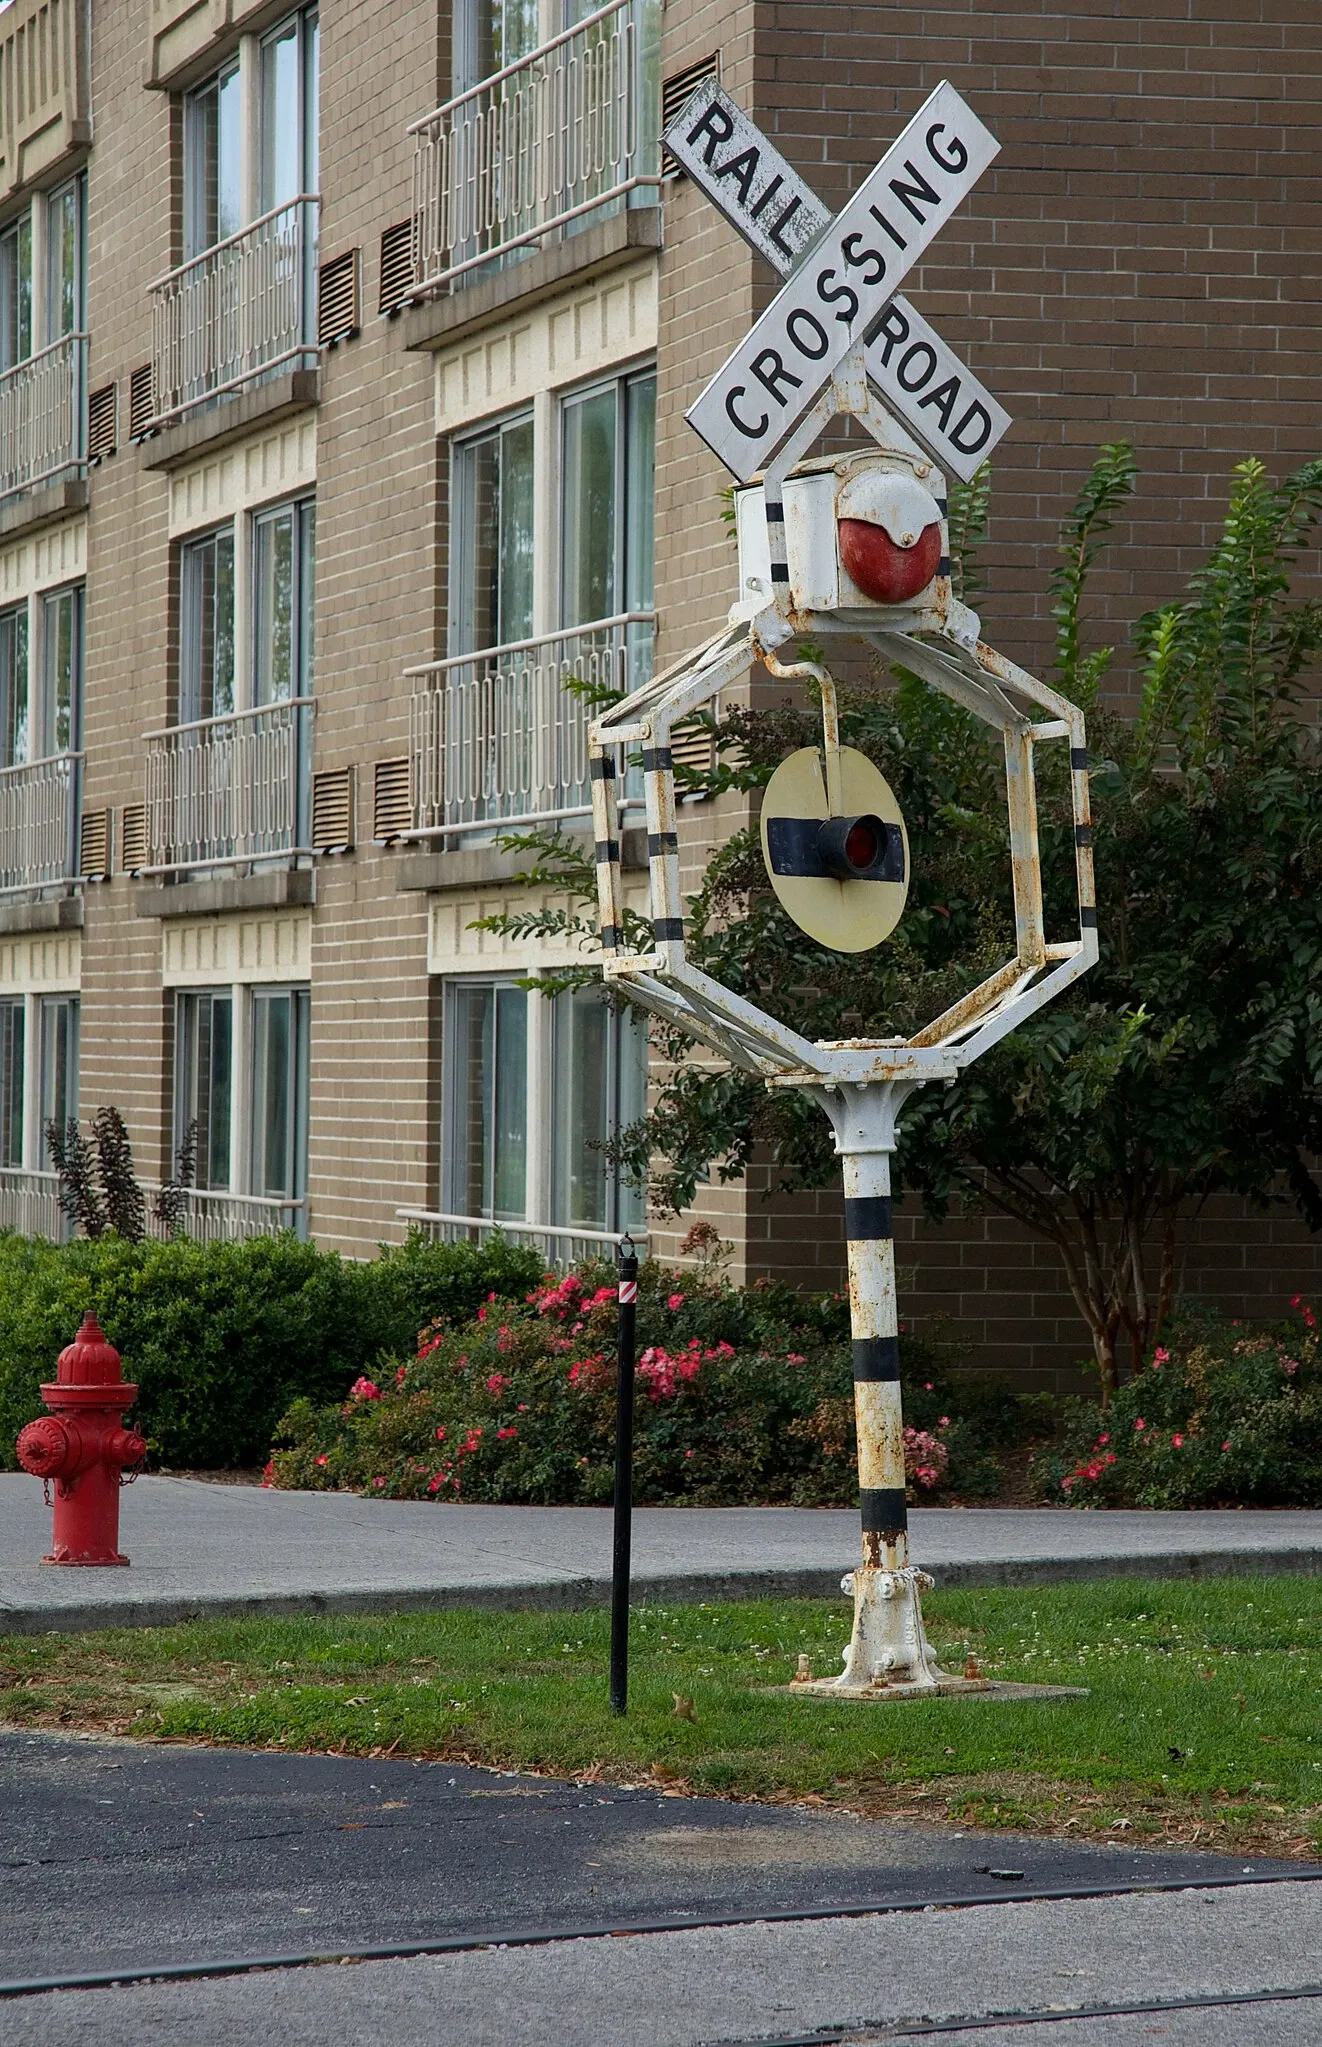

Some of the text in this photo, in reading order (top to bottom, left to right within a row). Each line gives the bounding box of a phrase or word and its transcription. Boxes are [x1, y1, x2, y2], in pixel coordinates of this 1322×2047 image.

[686, 101, 992, 455] RAIL ROAD
[725, 124, 968, 439] CROSSING
